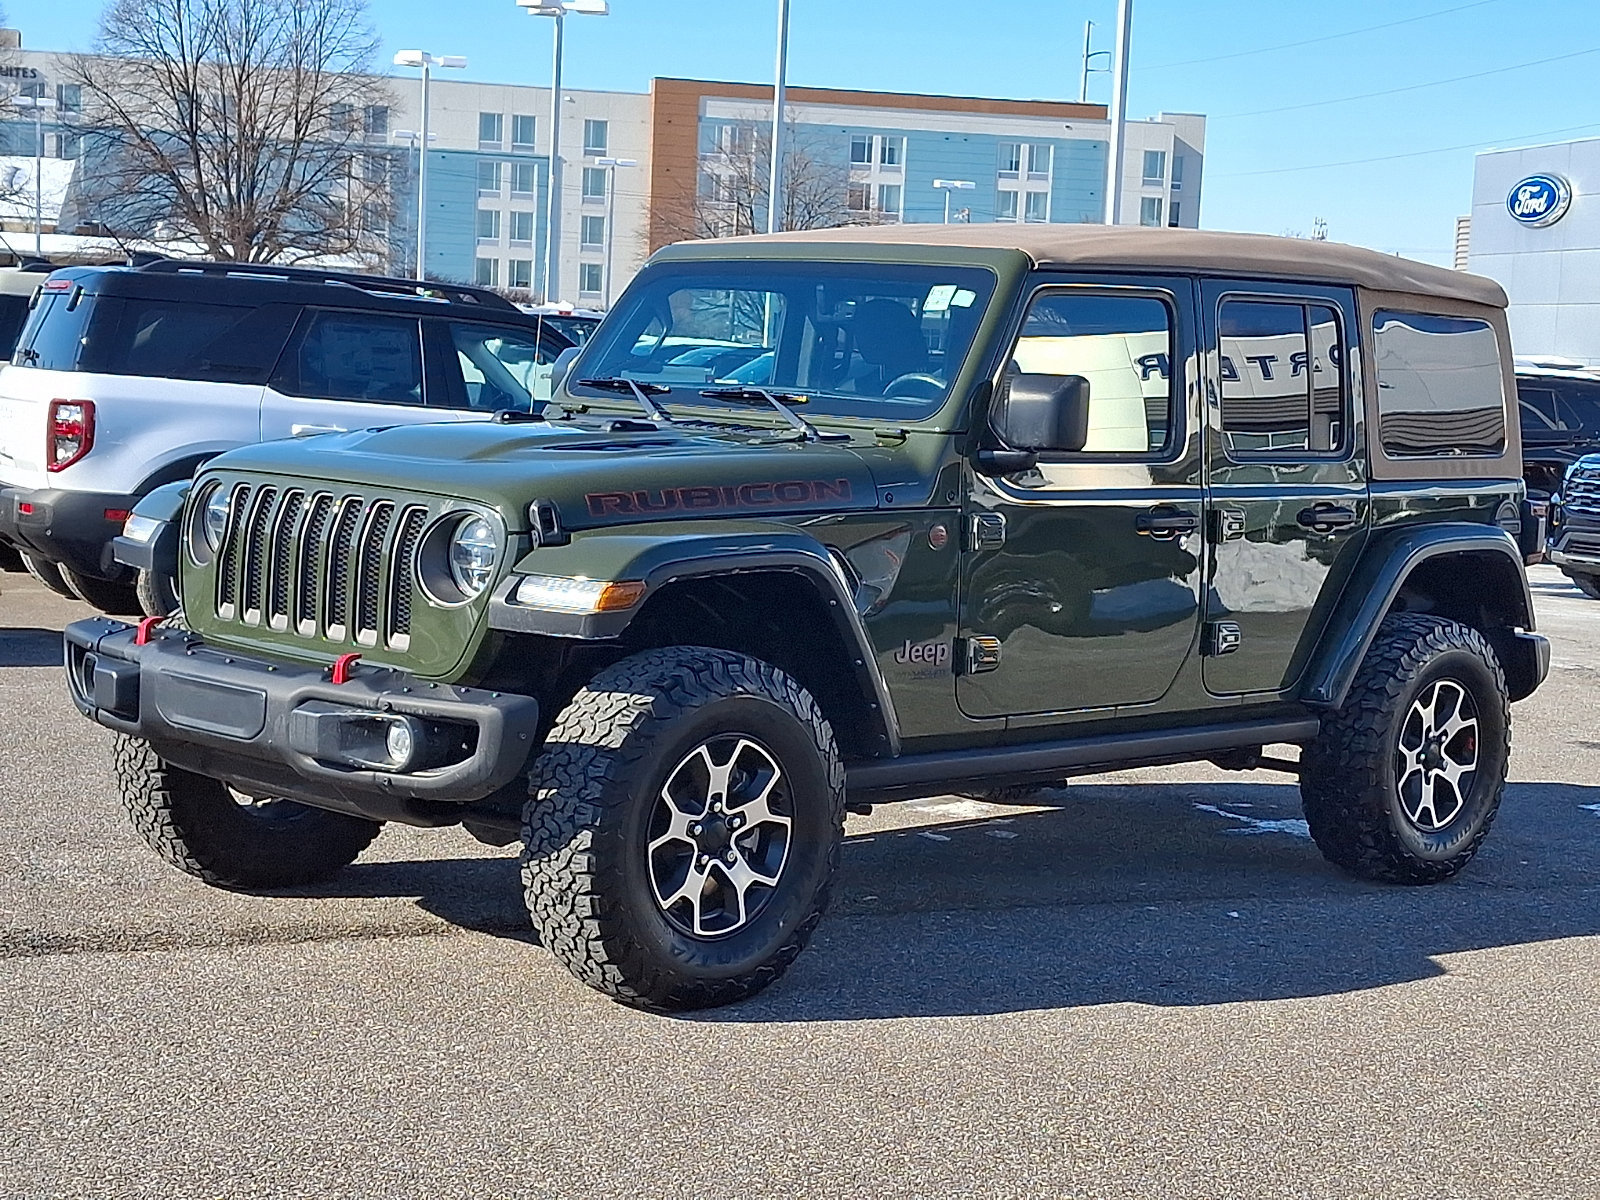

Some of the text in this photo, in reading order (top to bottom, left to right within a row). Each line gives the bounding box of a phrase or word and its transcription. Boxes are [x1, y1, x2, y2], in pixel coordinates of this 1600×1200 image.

[1514, 185, 1549, 215] Ford
[584, 478, 852, 517] RUBICON
[894, 639, 949, 666] Jeep
